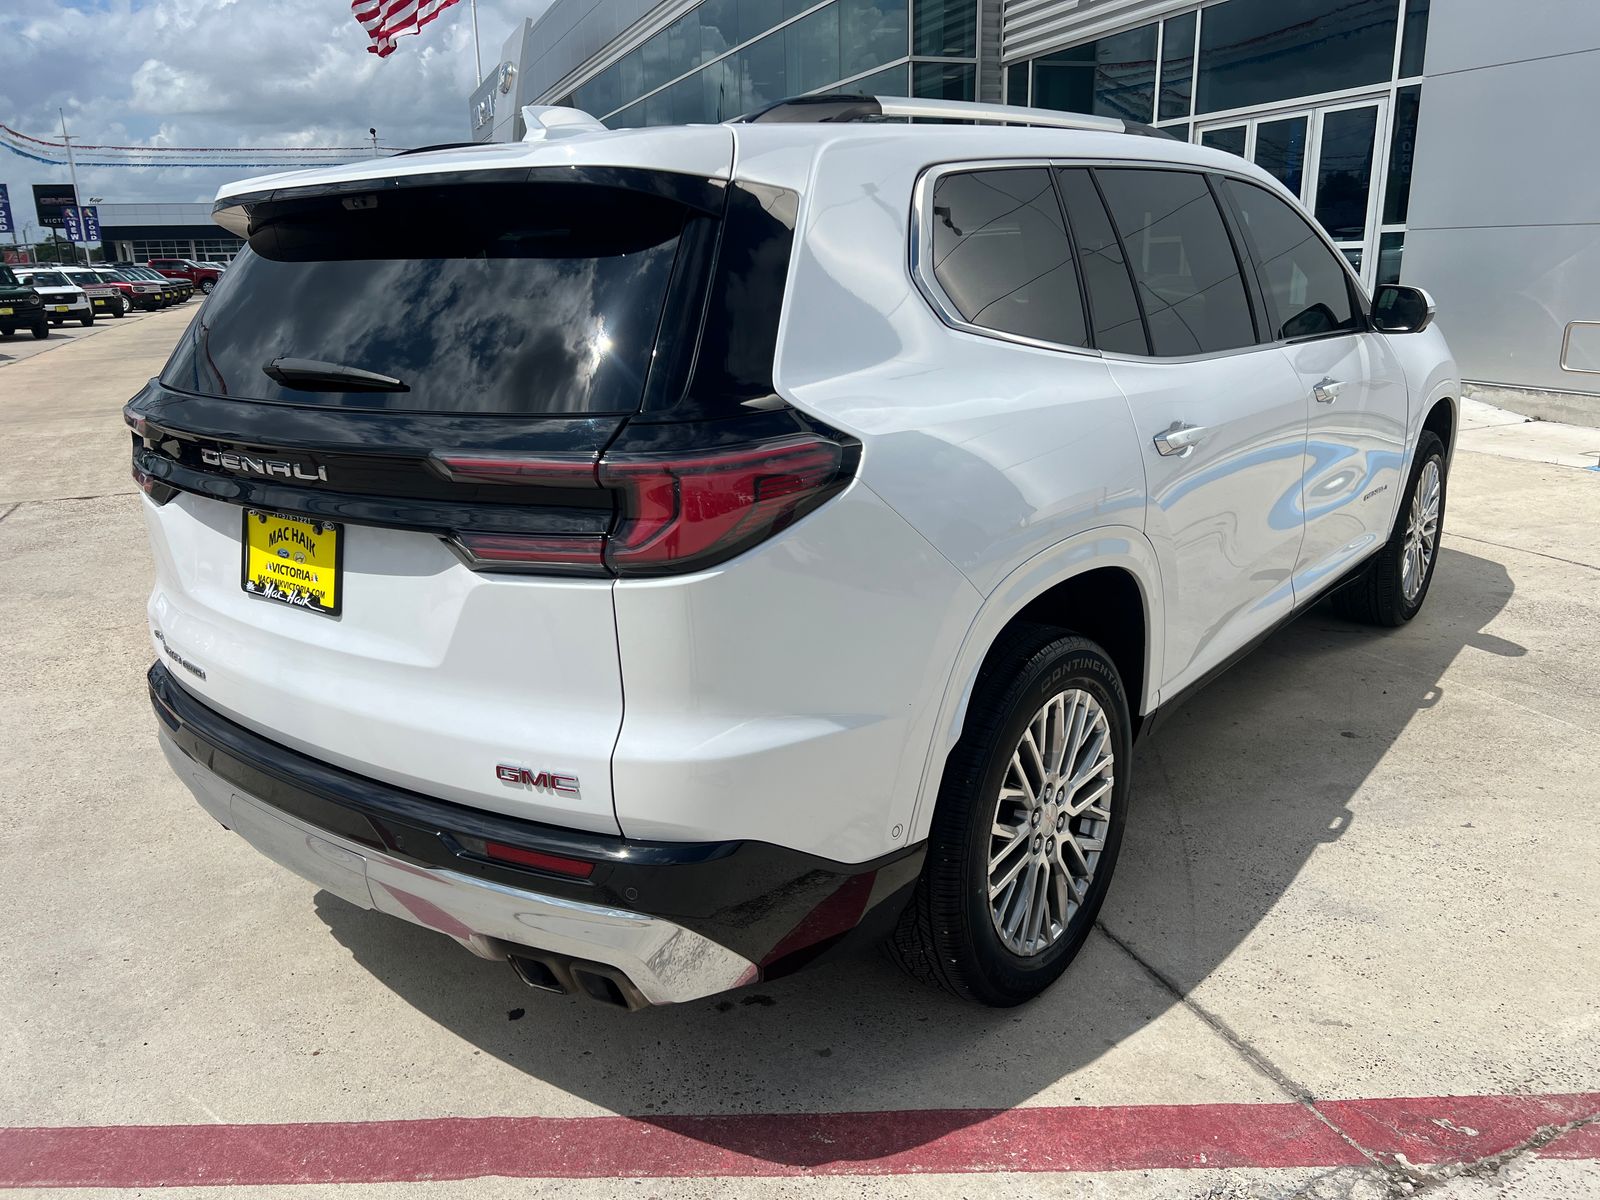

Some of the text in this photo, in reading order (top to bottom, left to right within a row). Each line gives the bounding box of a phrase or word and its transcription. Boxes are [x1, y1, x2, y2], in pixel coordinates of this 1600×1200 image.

[40, 197, 76, 205] GMC
[68, 220, 79, 240] NEW
[88, 219, 98, 240] FORD
[201, 448, 327, 481] DENALI
[268, 526, 316, 558] MAC HAIK
[271, 562, 311, 581] VICTORIA
[257, 574, 326, 599] MACHAIKVICTORIA.COM
[263, 583, 318, 610] Mac Haik
[1041, 657, 1123, 701] CONTINENTAL
[496, 764, 580, 793] GMC
